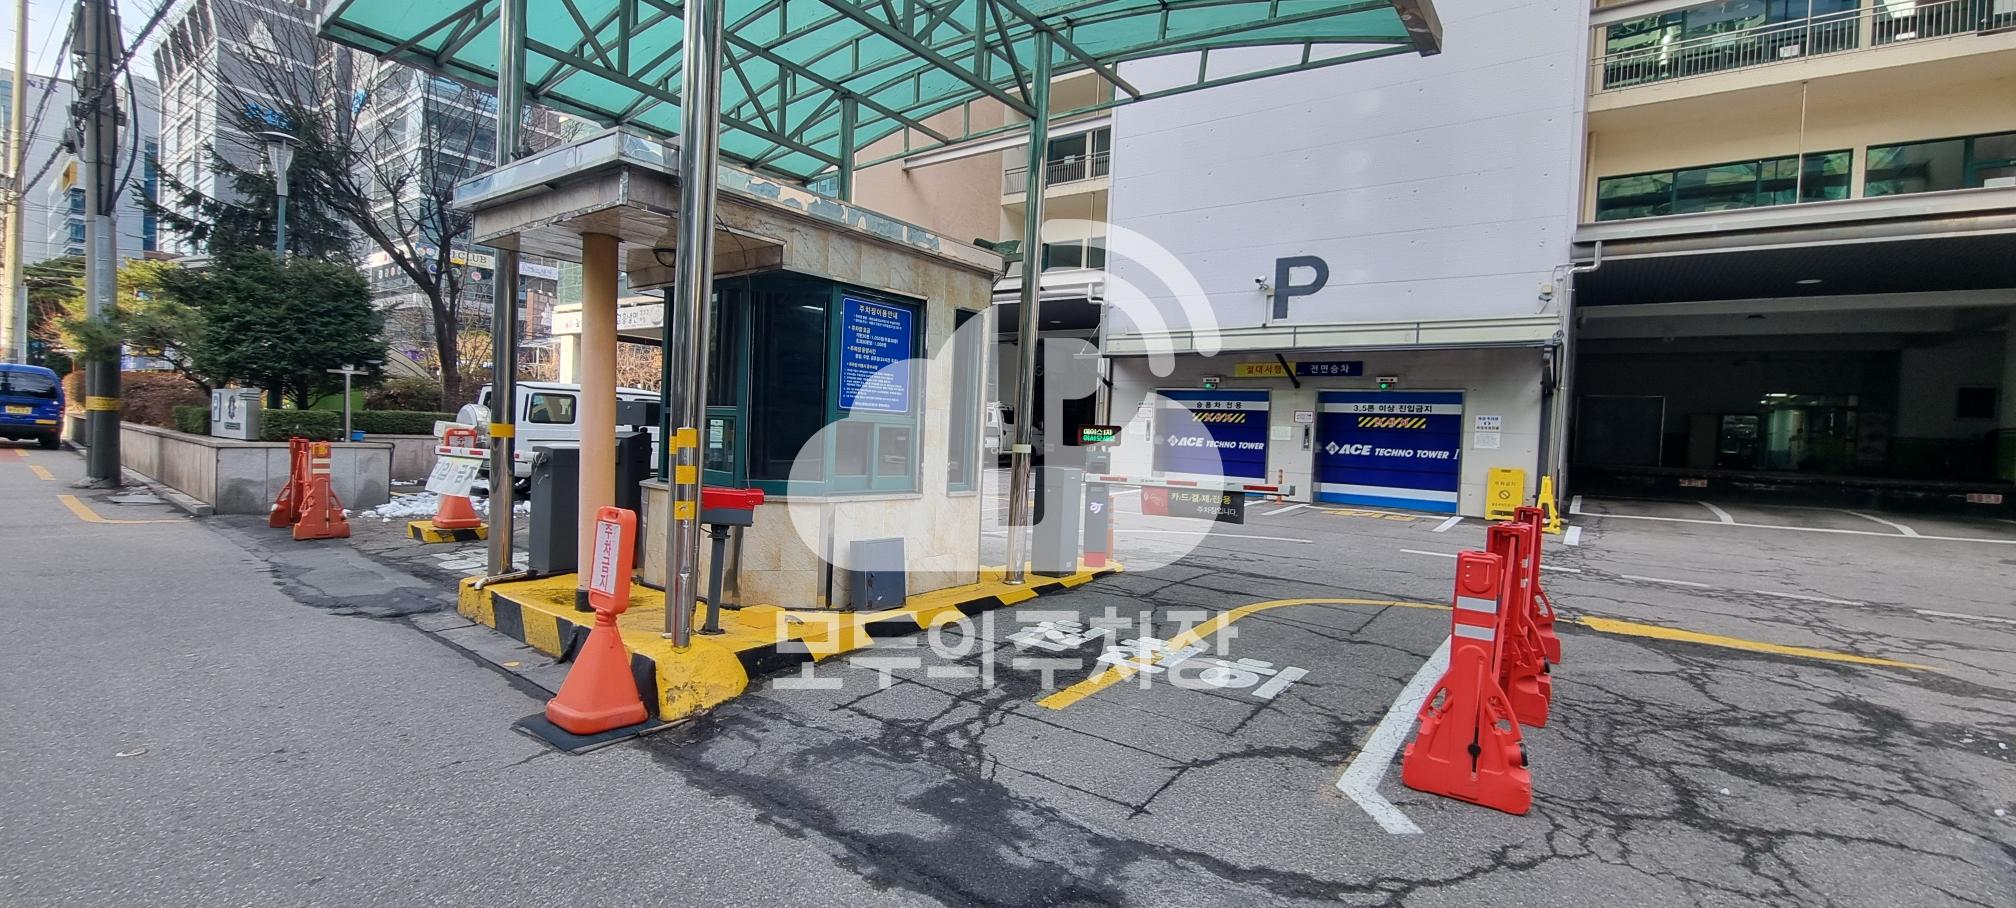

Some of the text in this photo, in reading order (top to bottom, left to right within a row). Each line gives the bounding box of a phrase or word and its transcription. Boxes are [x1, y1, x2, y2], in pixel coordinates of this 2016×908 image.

[1272, 255, 1329, 319] P
[1378, 405, 1395, 413] 이상
[1398, 404, 1433, 413] 진입금지
[1178, 437, 1265, 450] ACE TECHNO TOWER
[1338, 444, 1372, 455] ACE
[1374, 448, 1414, 458] TECHNO
[1416, 450, 1450, 459] TOWER
[599, 523, 613, 591] 주차금지
